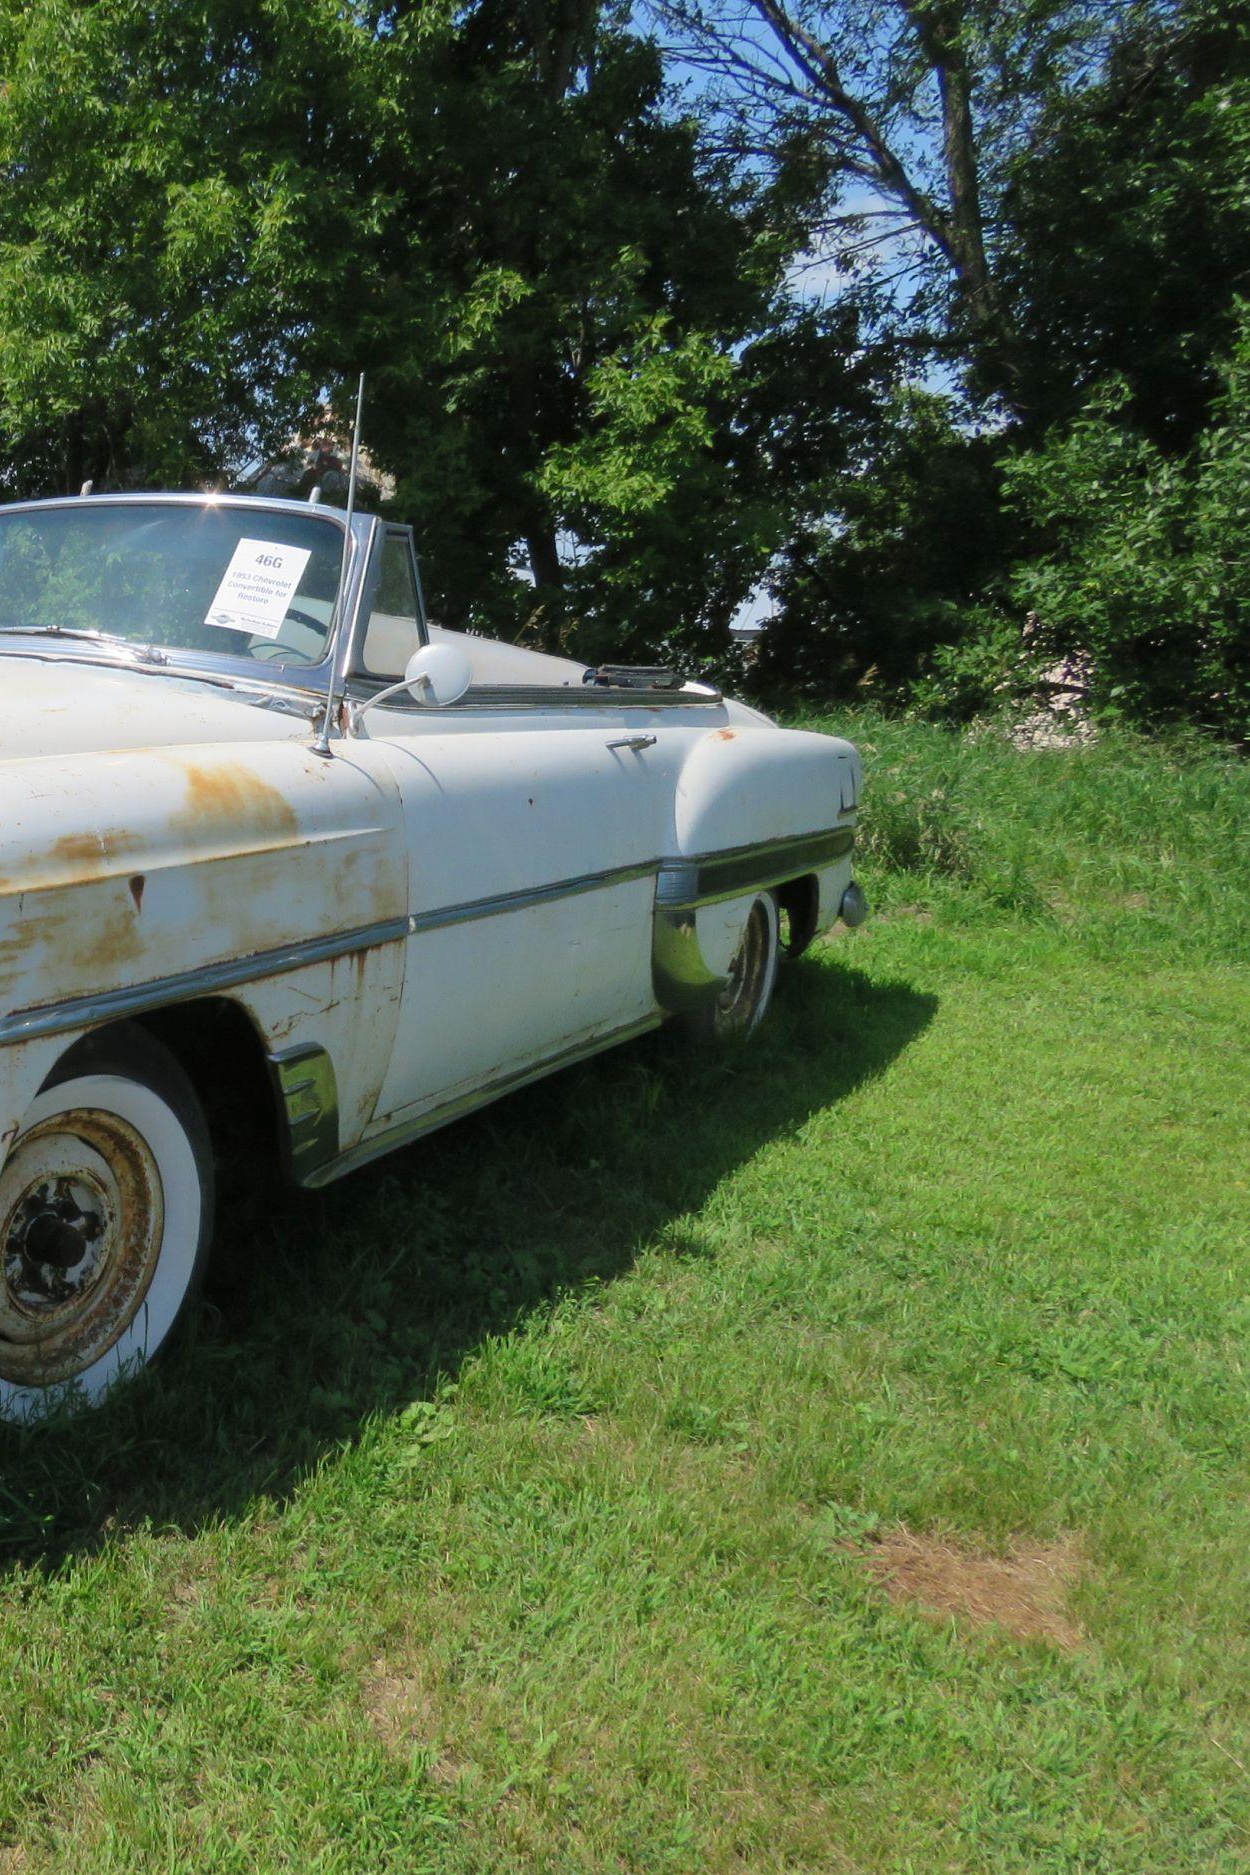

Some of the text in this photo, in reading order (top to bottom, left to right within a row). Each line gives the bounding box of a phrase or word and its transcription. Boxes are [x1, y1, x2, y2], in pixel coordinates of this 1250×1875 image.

[255, 554, 283, 569] 46G
[232, 571, 292, 589] 1953 Chevrolet
[228, 581, 288, 598] Convertible for
[237, 592, 269, 604] Restore
